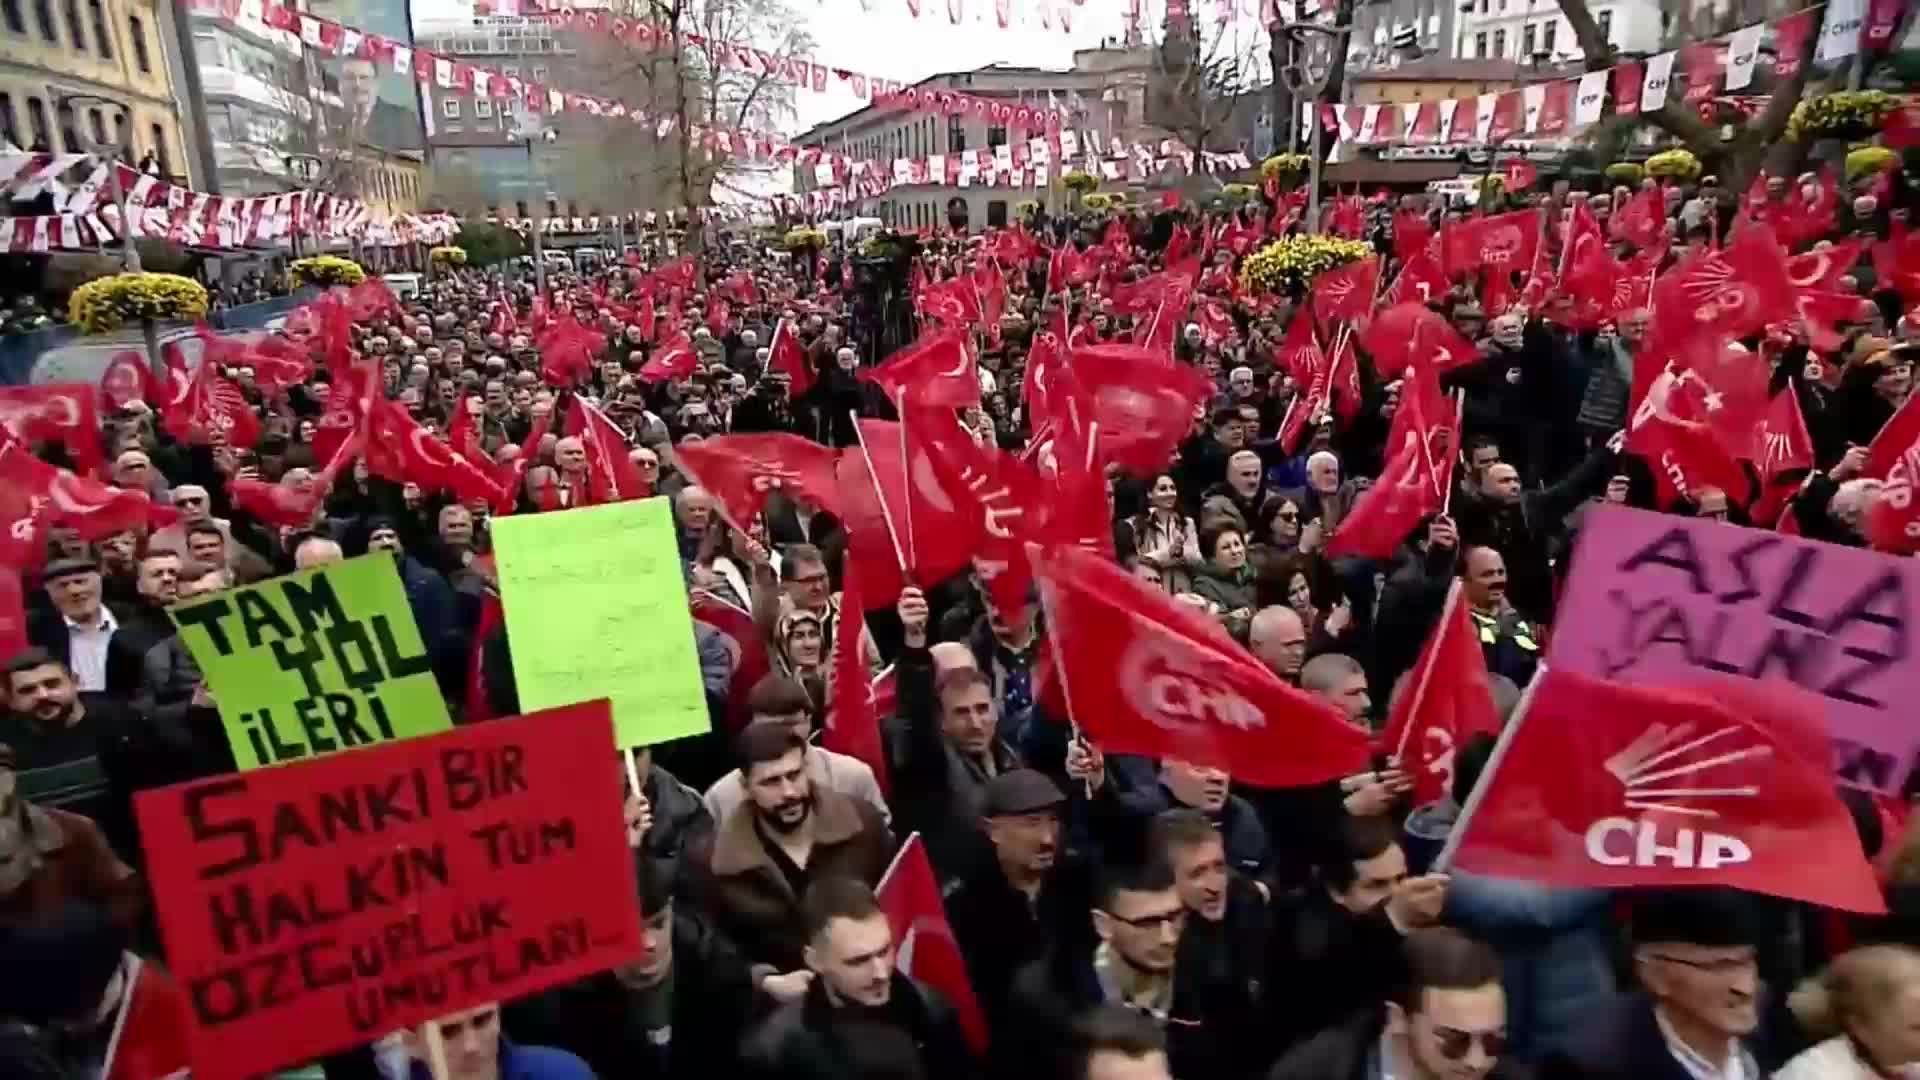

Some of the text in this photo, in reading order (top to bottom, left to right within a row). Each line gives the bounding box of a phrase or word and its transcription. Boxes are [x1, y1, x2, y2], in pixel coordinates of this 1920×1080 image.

[175, 571, 350, 656] TAM
[1616, 528, 1906, 657] ASLA
[270, 613, 434, 698] YOL
[1585, 816, 1752, 869] CHP
